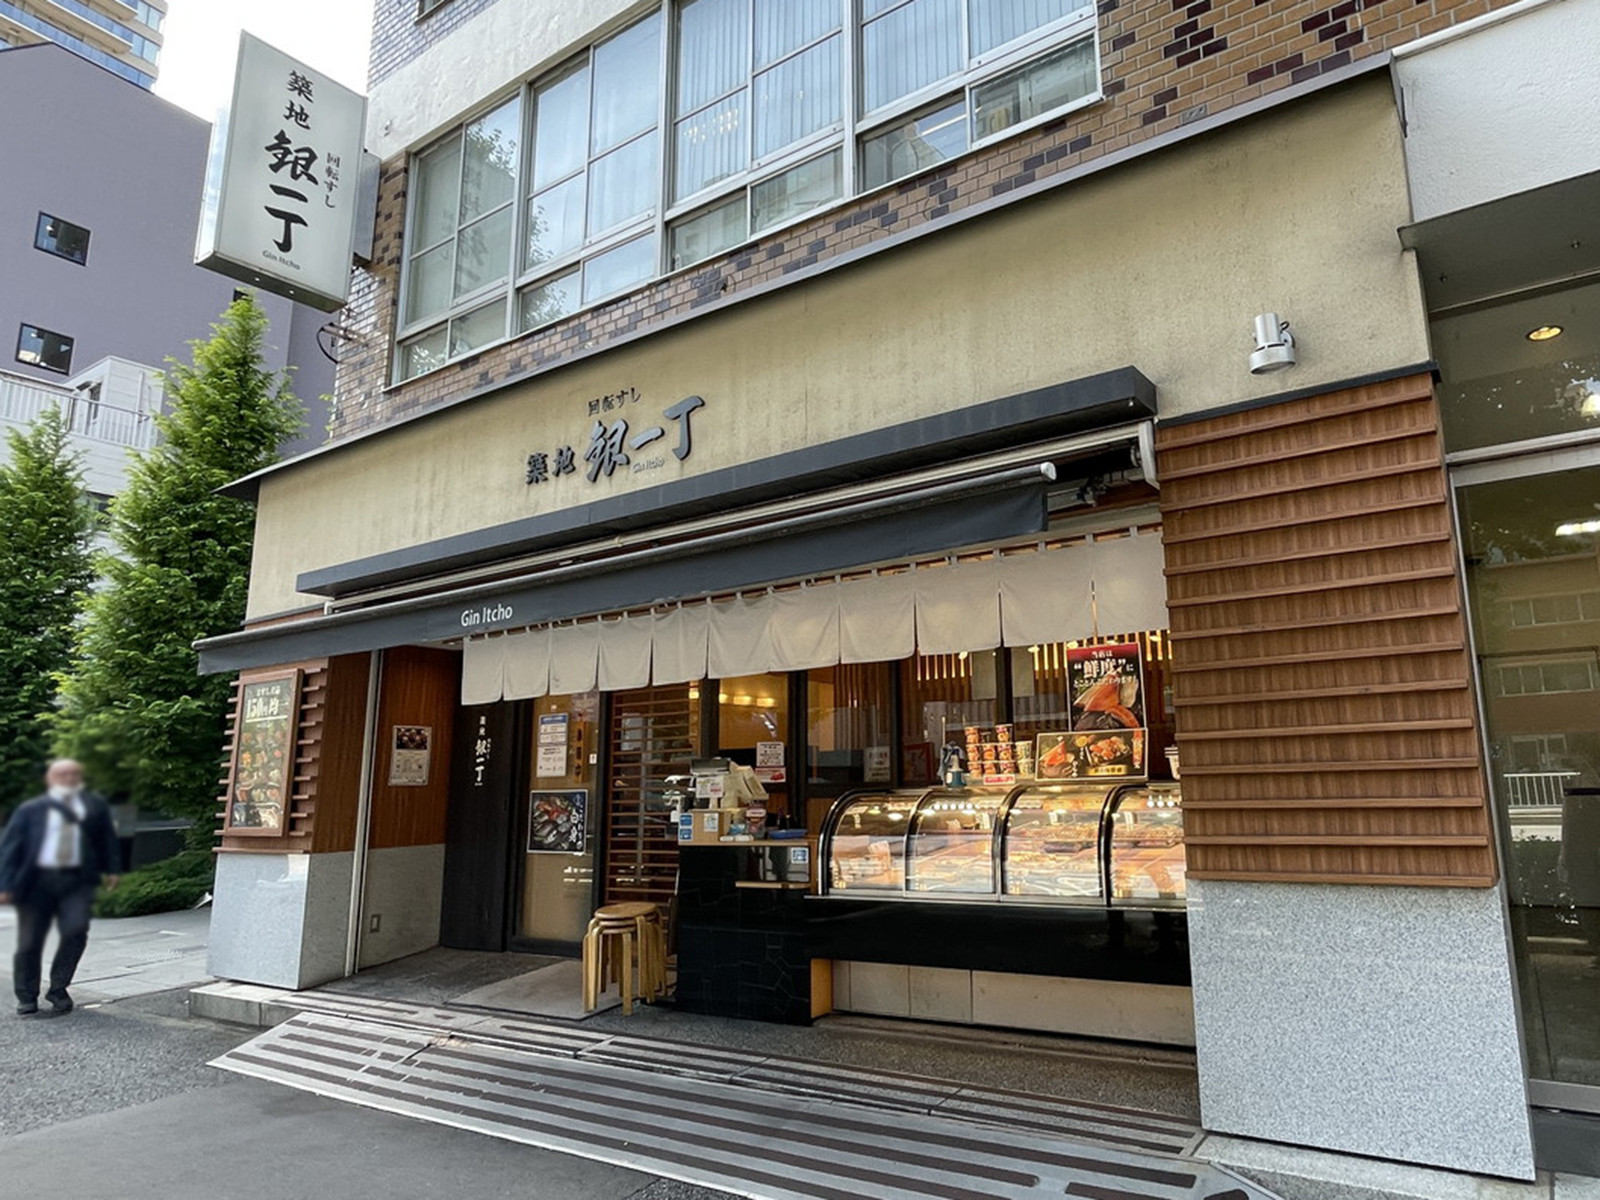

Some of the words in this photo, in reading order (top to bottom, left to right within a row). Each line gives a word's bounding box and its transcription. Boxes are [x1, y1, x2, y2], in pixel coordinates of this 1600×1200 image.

[323, 151, 341, 208] 回転すし
[262, 249, 278, 261] Gin
[278, 255, 301, 271] Itcho
[587, 386, 642, 417] 回転すし
[460, 609, 480, 627] Gin
[482, 603, 513, 623] Itcho
